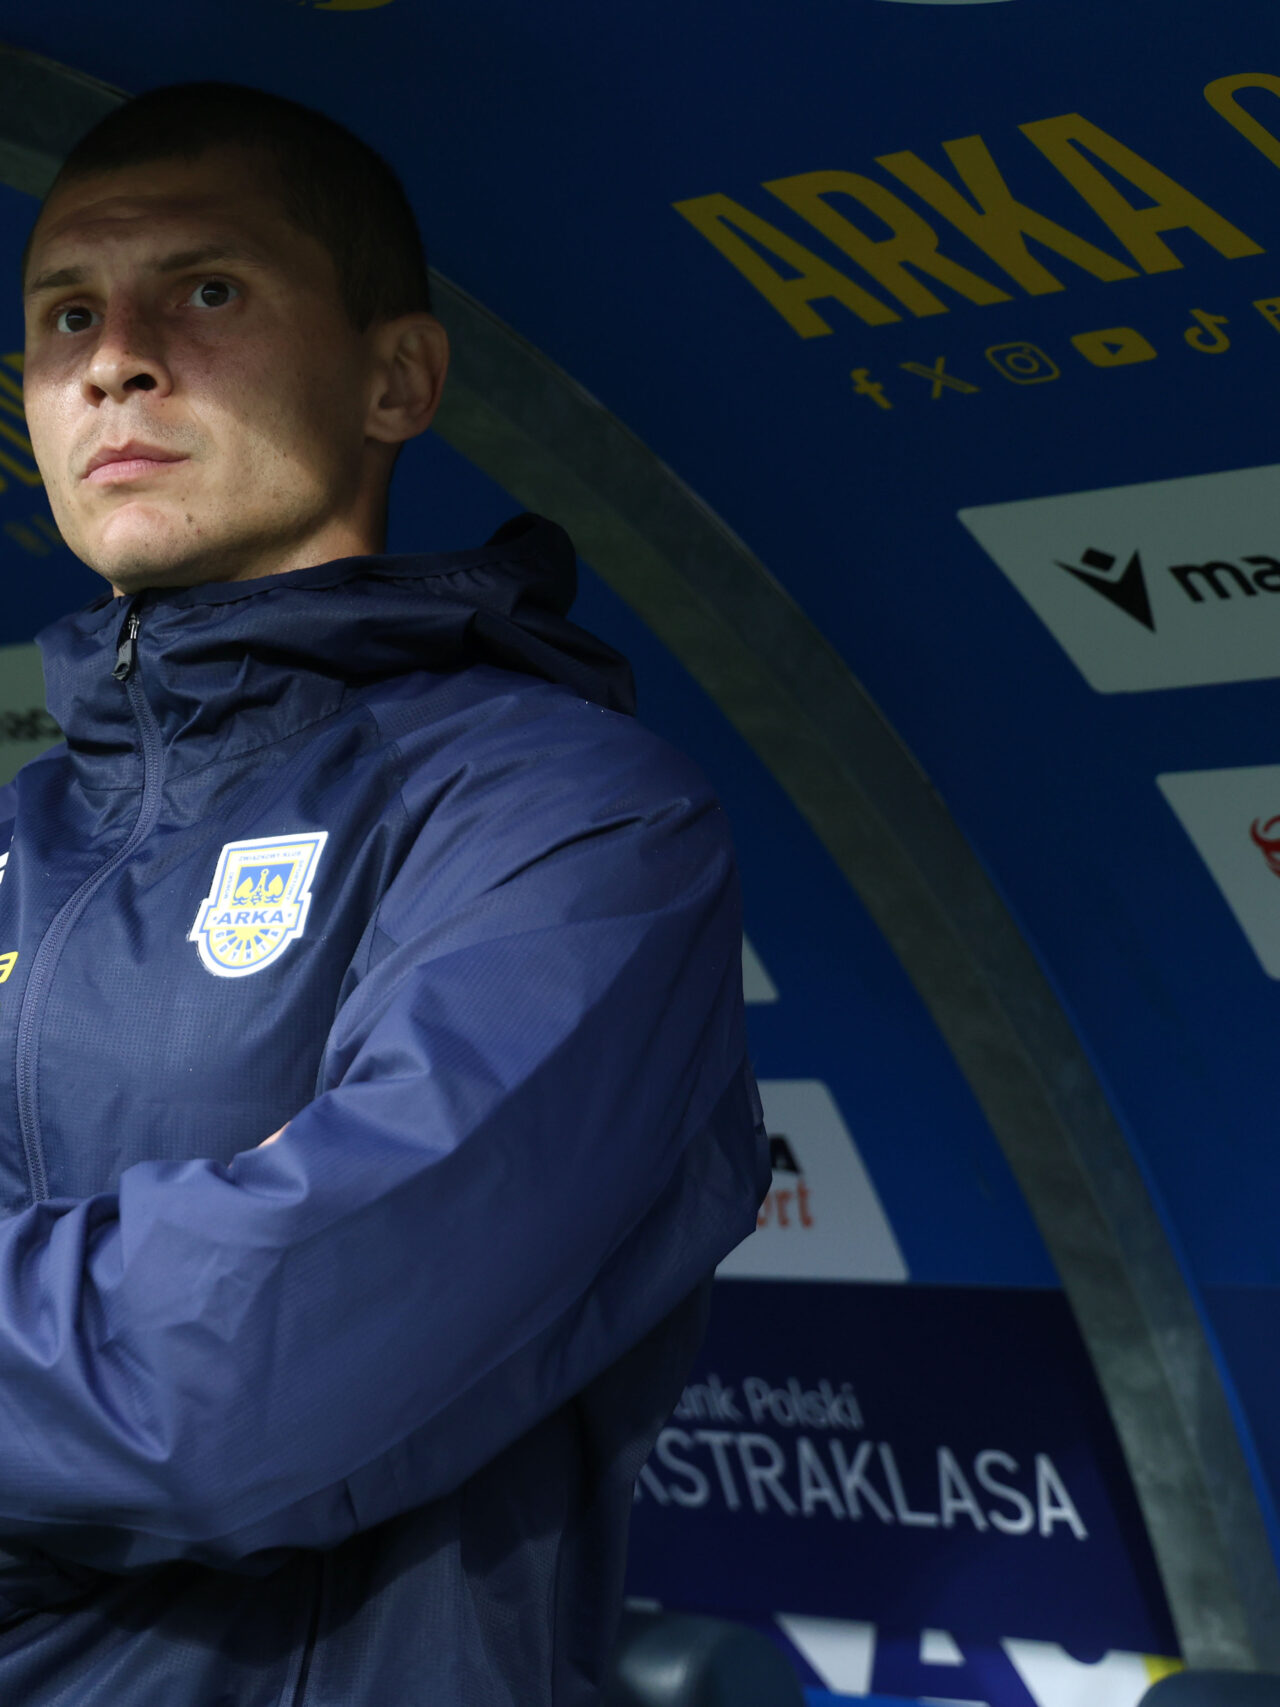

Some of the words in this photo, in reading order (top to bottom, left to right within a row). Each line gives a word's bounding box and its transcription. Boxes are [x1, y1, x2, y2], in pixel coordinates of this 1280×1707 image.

[670, 112, 1267, 340] ARKA
[217, 910, 284, 925] ARKA
[742, 1376, 864, 1430] Polski
